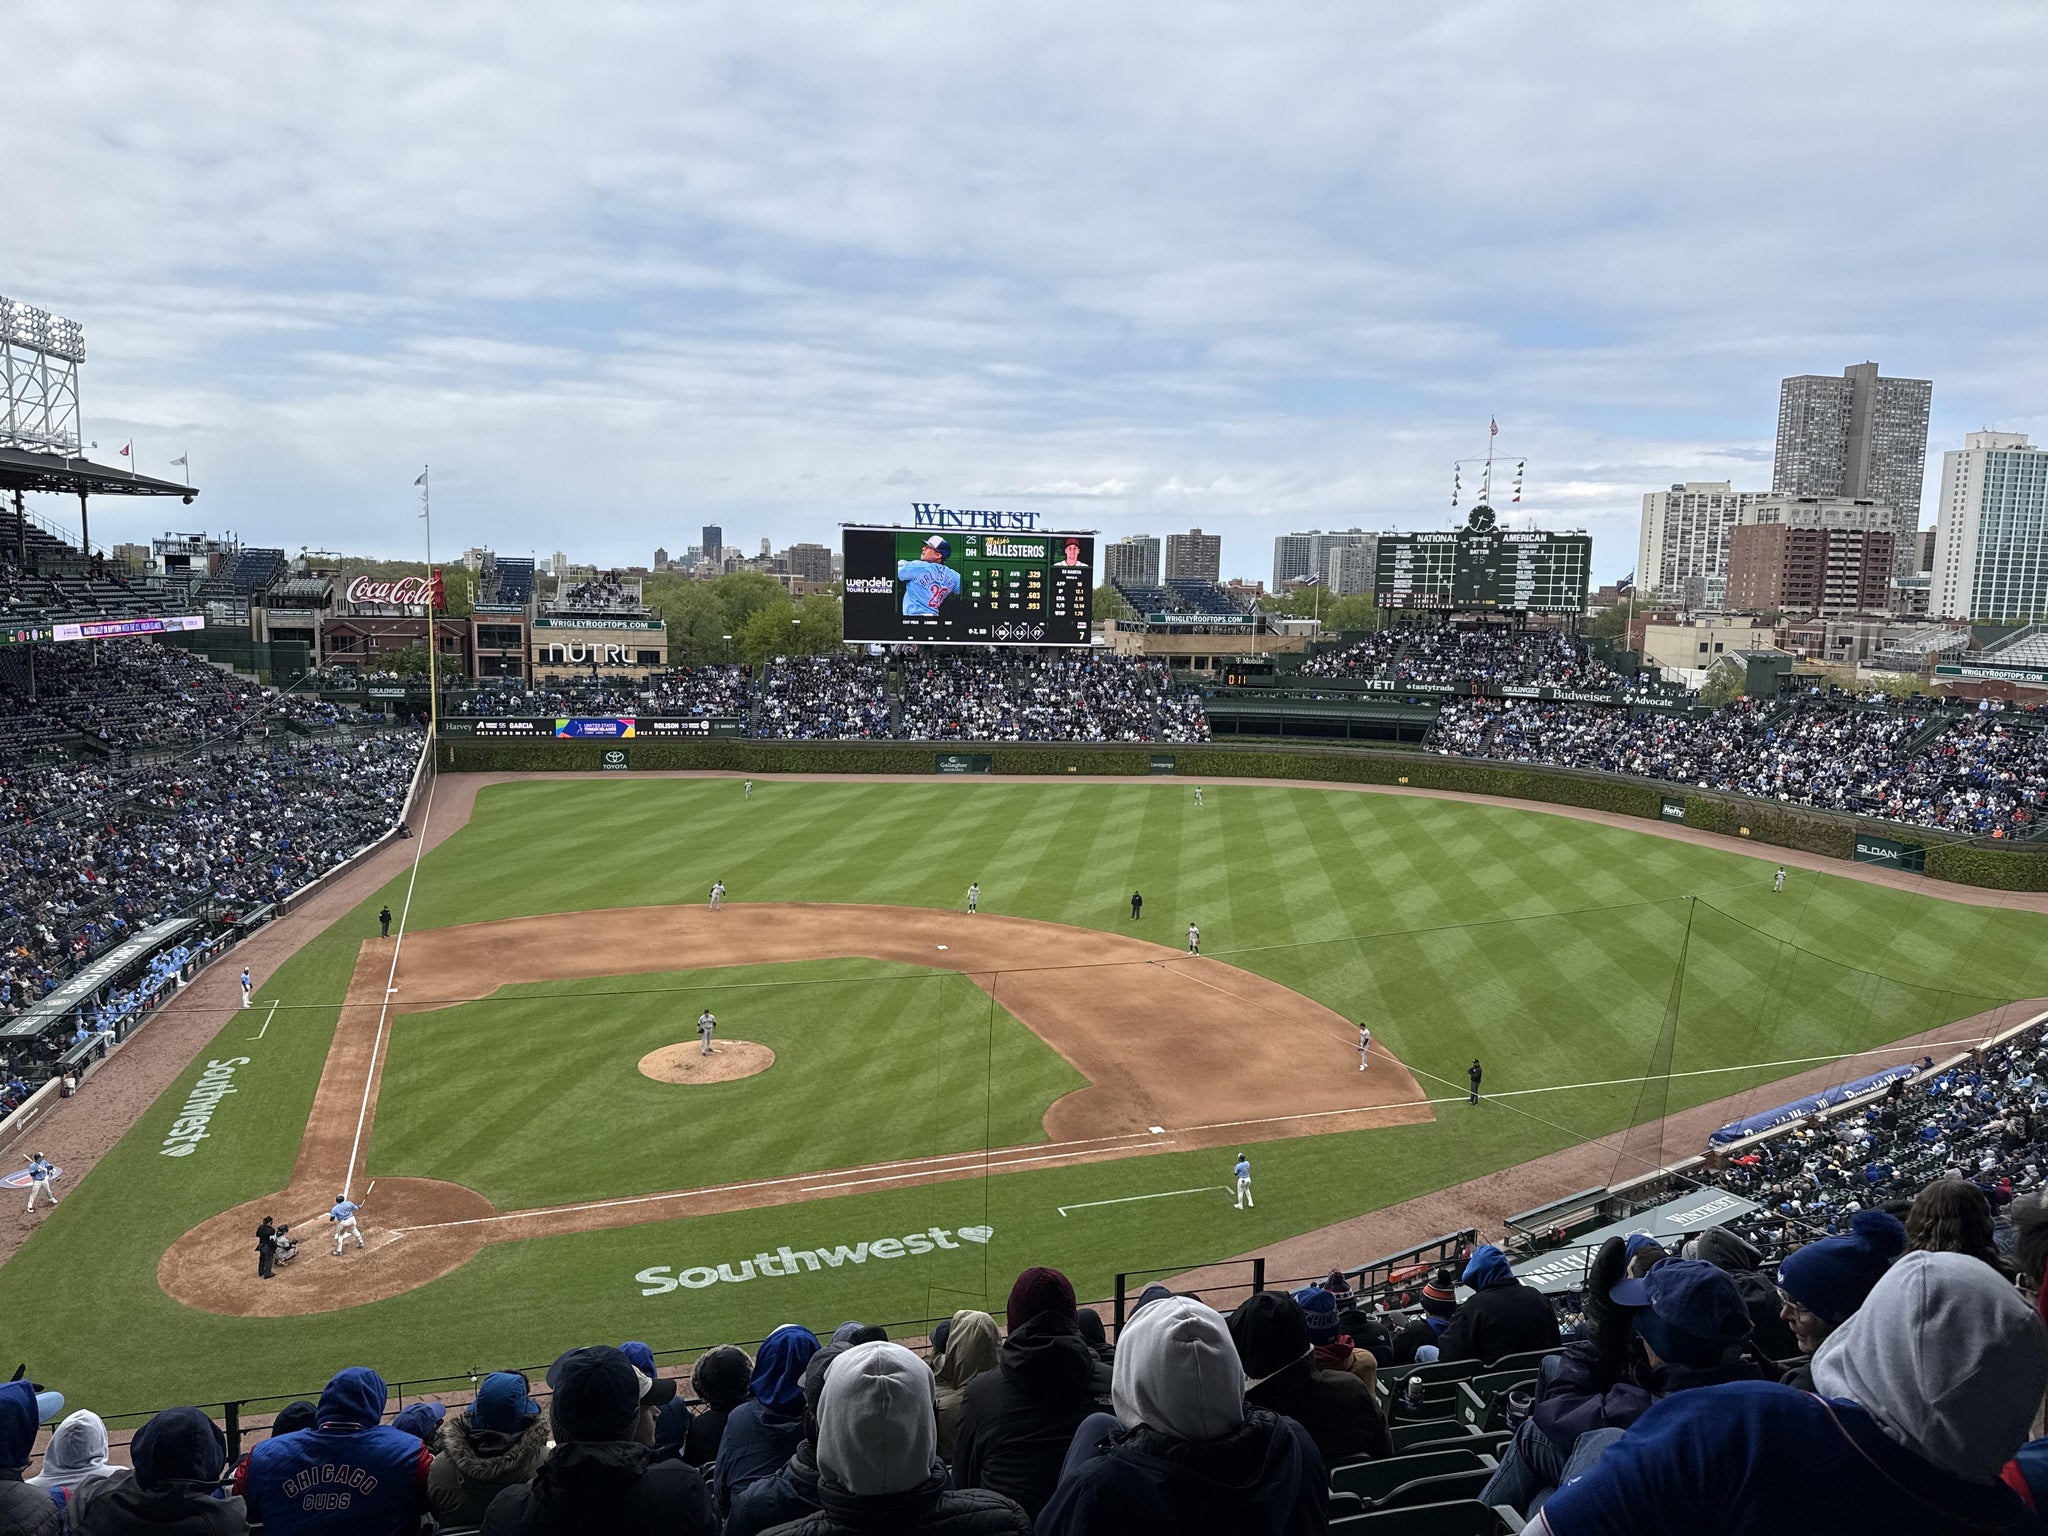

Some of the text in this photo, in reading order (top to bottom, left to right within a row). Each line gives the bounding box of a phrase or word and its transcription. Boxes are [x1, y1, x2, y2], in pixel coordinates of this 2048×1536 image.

[912, 503, 1040, 530] WINTRUST
[965, 535, 977, 545] 25
[1416, 534, 1458, 543] NATIONAL
[1502, 533, 1547, 542] AMERICAN
[965, 548, 977, 557] DH
[986, 544, 1045, 558] BALLESTEROS
[1472, 555, 1486, 565] 25
[846, 576, 894, 588] wendella
[1487, 572, 1494, 581] 2
[346, 575, 440, 606] Coca-Cola
[1026, 602, 1041, 610] .993
[549, 619, 648, 629] WRIGLEYROOFTOPS.COM
[1164, 615, 1243, 623] WRIGLEYROOFTOPS.COM
[1079, 631, 1085, 640] 7
[549, 638, 634, 663] NÜTRL
[1961, 668, 2043, 681] WRIGLEYROOFTOPS.COM
[1364, 679, 1395, 690] YETI
[1412, 683, 1455, 692] tastytrade
[1502, 685, 1541, 694] GRAINGER
[368, 687, 406, 695] GRAINGER
[1553, 689, 1611, 703] Budweiser
[1634, 697, 1673, 707] Advocate
[445, 722, 474, 732] Harvey
[1663, 805, 1684, 817] Hefty
[1856, 844, 1897, 859] SLOAN
[162, 1056, 251, 1146] Southwest
[1665, 1195, 1736, 1225] WINTRUST
[634, 1226, 961, 1297] Southwest
[1524, 1253, 1588, 1286] WRIGLEY
[282, 1463, 378, 1498] CHICAGO
[302, 1492, 351, 1511] CUBS
